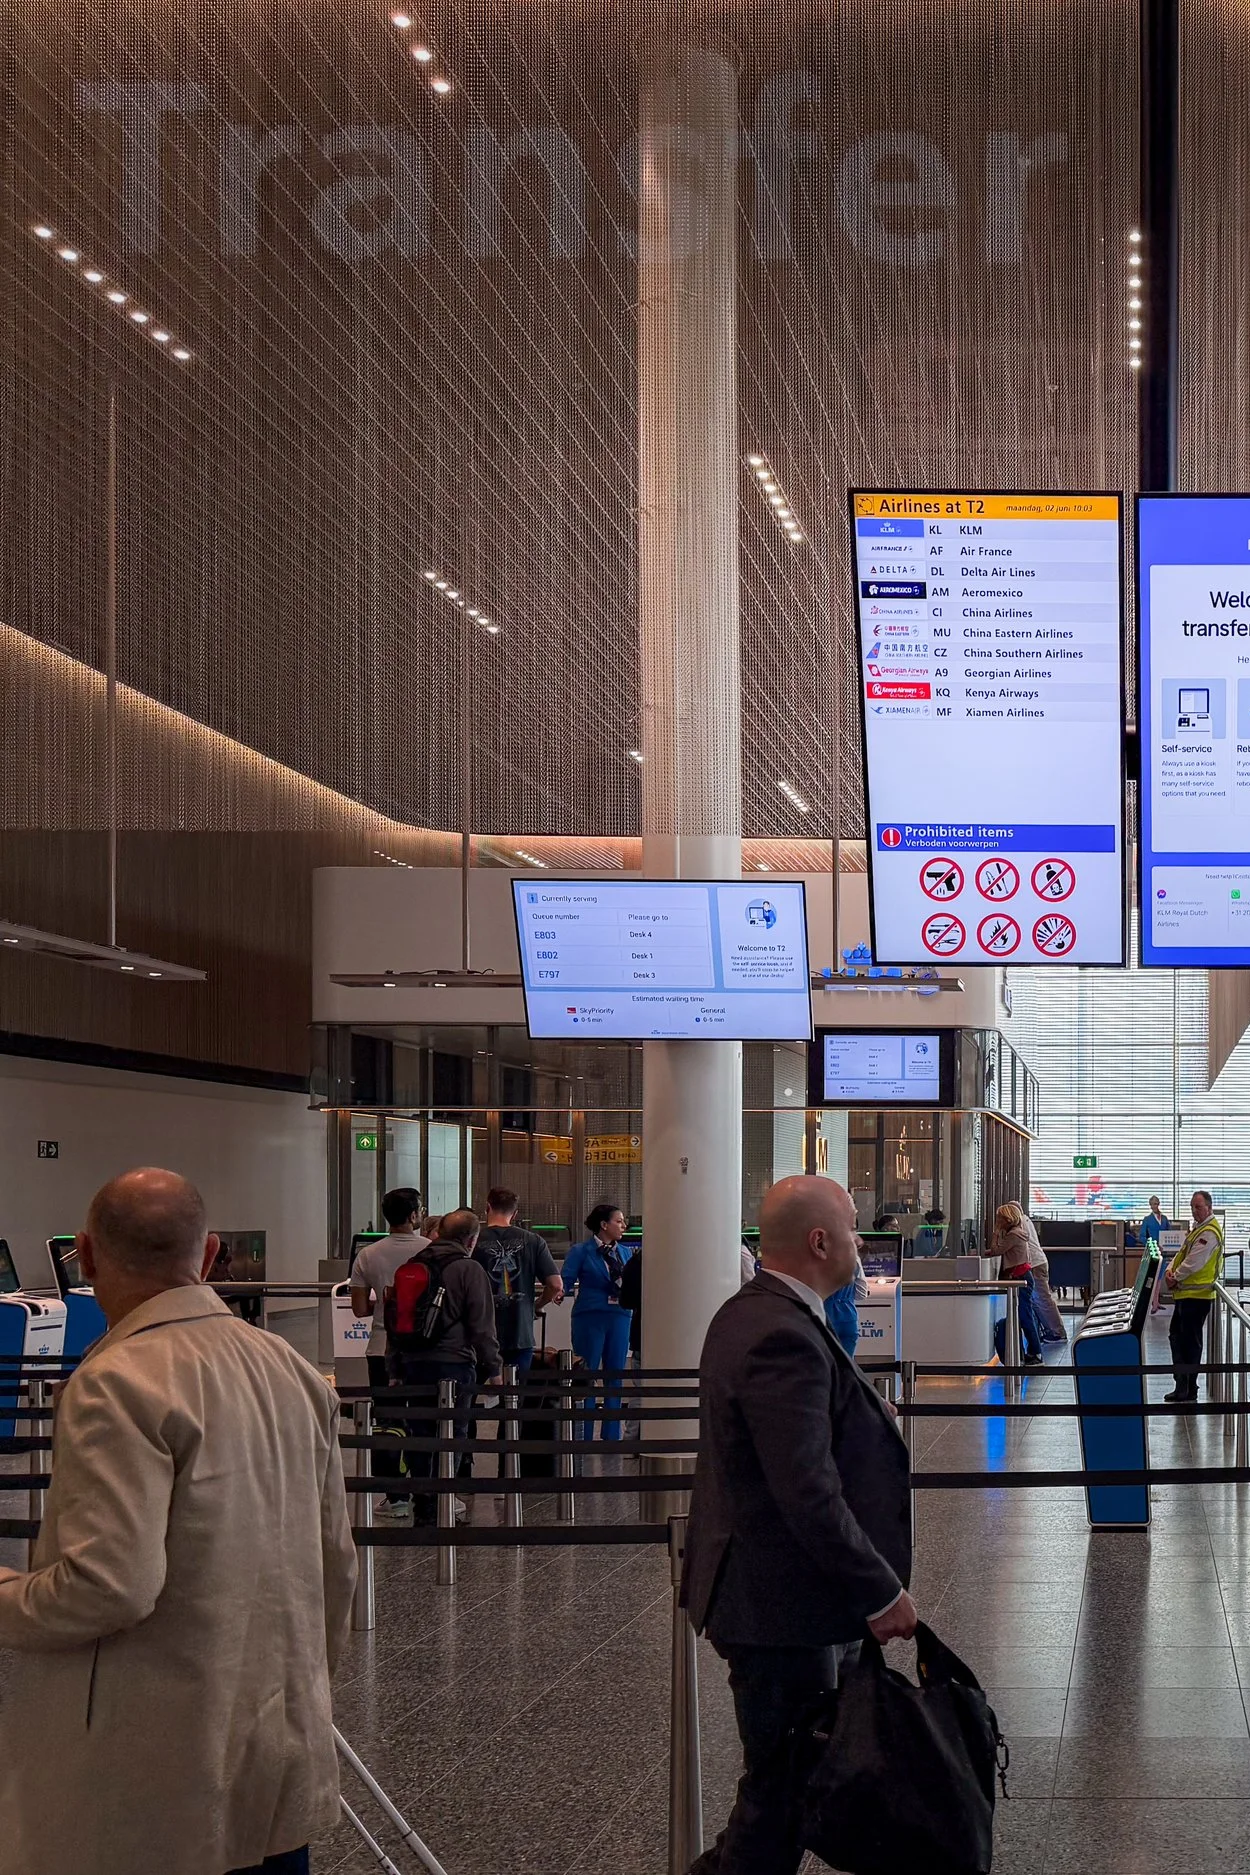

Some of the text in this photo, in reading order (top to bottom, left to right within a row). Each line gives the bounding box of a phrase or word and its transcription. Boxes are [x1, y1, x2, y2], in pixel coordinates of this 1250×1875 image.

[82, 70, 1067, 264] Transfer
[880, 498, 984, 513] Airlines at T2
[930, 526, 982, 535] KL KLM
[930, 546, 1012, 556] AF Air France
[931, 567, 1035, 577] DL Delta Air Lines
[932, 588, 1023, 597] AM Aeromexico
[932, 608, 1032, 617] CI China Airlines
[934, 628, 1073, 638] MU China Eastern Airlines
[934, 648, 947, 657] CZ
[964, 648, 992, 657] China
[996, 649, 1041, 658] Southern
[1045, 649, 1083, 658] Airlines
[935, 668, 1051, 680] A9 Georgian Airlines
[936, 688, 1038, 700] KQ Kenya Airways
[966, 708, 1003, 716] Xiamen
[1007, 708, 1044, 717] Airlines
[906, 826, 1016, 838] Prohibited items
